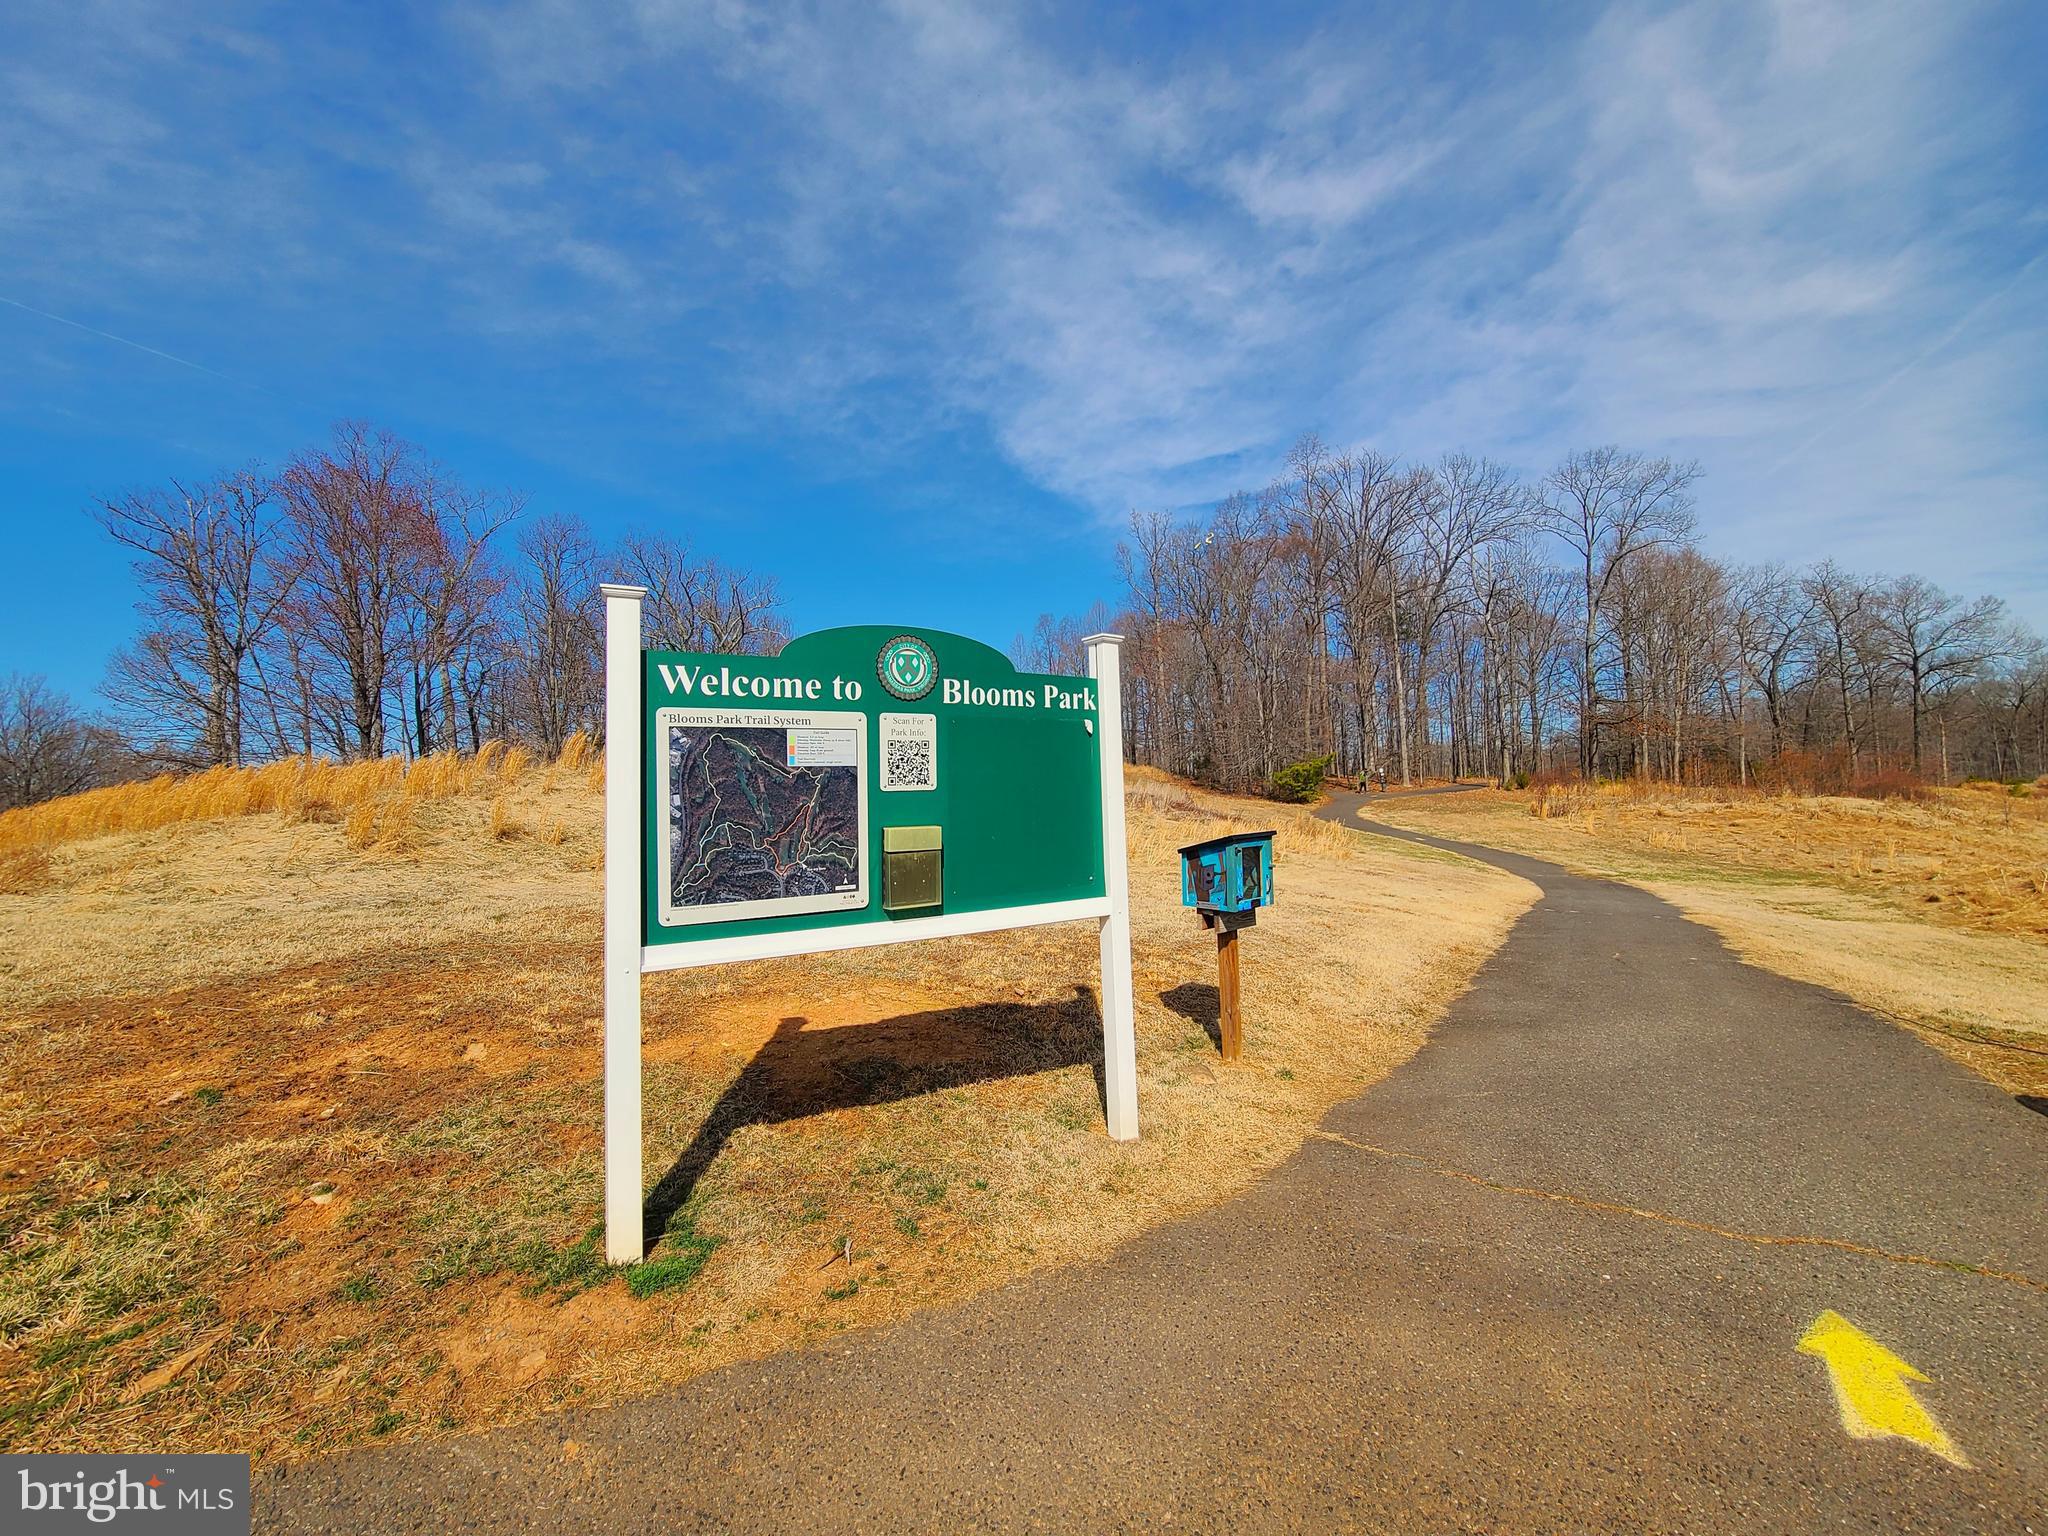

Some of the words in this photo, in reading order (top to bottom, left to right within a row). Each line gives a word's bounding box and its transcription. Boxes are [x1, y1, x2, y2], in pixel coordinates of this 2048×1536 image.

[657, 664, 822, 700] Welcome
[832, 675, 863, 701] to
[943, 678, 1035, 708] Blooms
[1044, 684, 1097, 711] Park
[668, 713, 713, 724] Blooms
[716, 714, 742, 725] Park
[744, 715, 771, 725] Trail
[773, 716, 811, 727] System
[892, 717, 910, 725] Scan
[912, 717, 925, 725] For
[891, 728, 907, 736] Park
[909, 728, 927, 737] Info:
